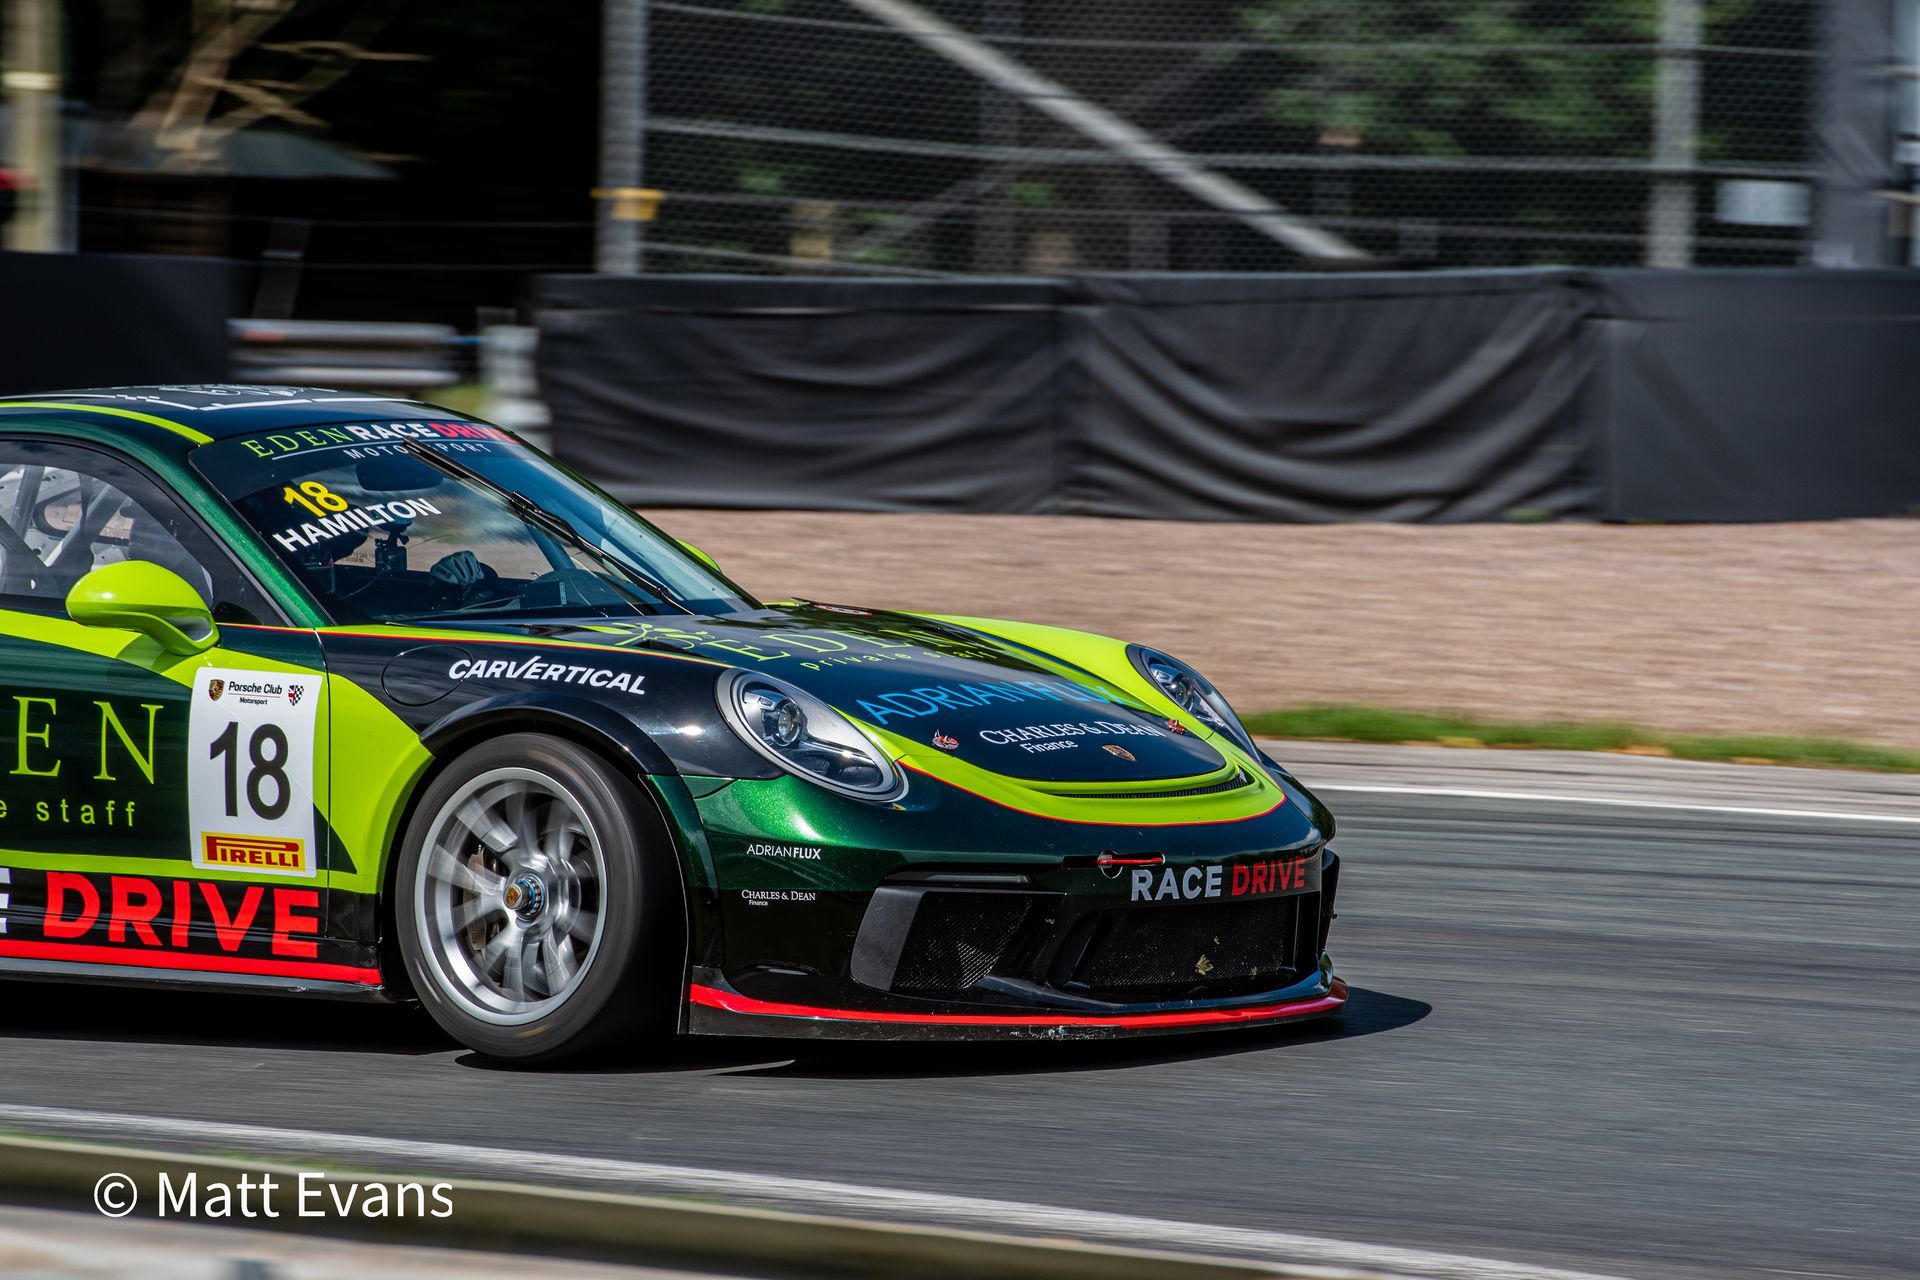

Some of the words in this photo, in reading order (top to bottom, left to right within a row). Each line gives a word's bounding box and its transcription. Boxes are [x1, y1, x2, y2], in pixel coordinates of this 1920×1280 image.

[284, 481, 348, 517] 18
[273, 498, 442, 552] HAMILTON
[449, 656, 645, 695] CARVERTICAL
[800, 651, 911, 671] private
[228, 681, 262, 694] Porsche
[263, 683, 283, 695] Club
[239, 697, 268, 705] Motorsport
[979, 723, 1085, 745] CHARLES
[1020, 740, 1078, 754] Finance
[210, 721, 291, 820] 18
[36, 799, 135, 826] staff
[206, 836, 300, 867] PIRELLI
[1131, 865, 1222, 901] RACE
[1232, 856, 1305, 896] DRIVE
[741, 889, 780, 900] CHARLES
[781, 892, 789, 900] &
[791, 891, 816, 901] DEAN
[43, 871, 319, 959] DRIVE
